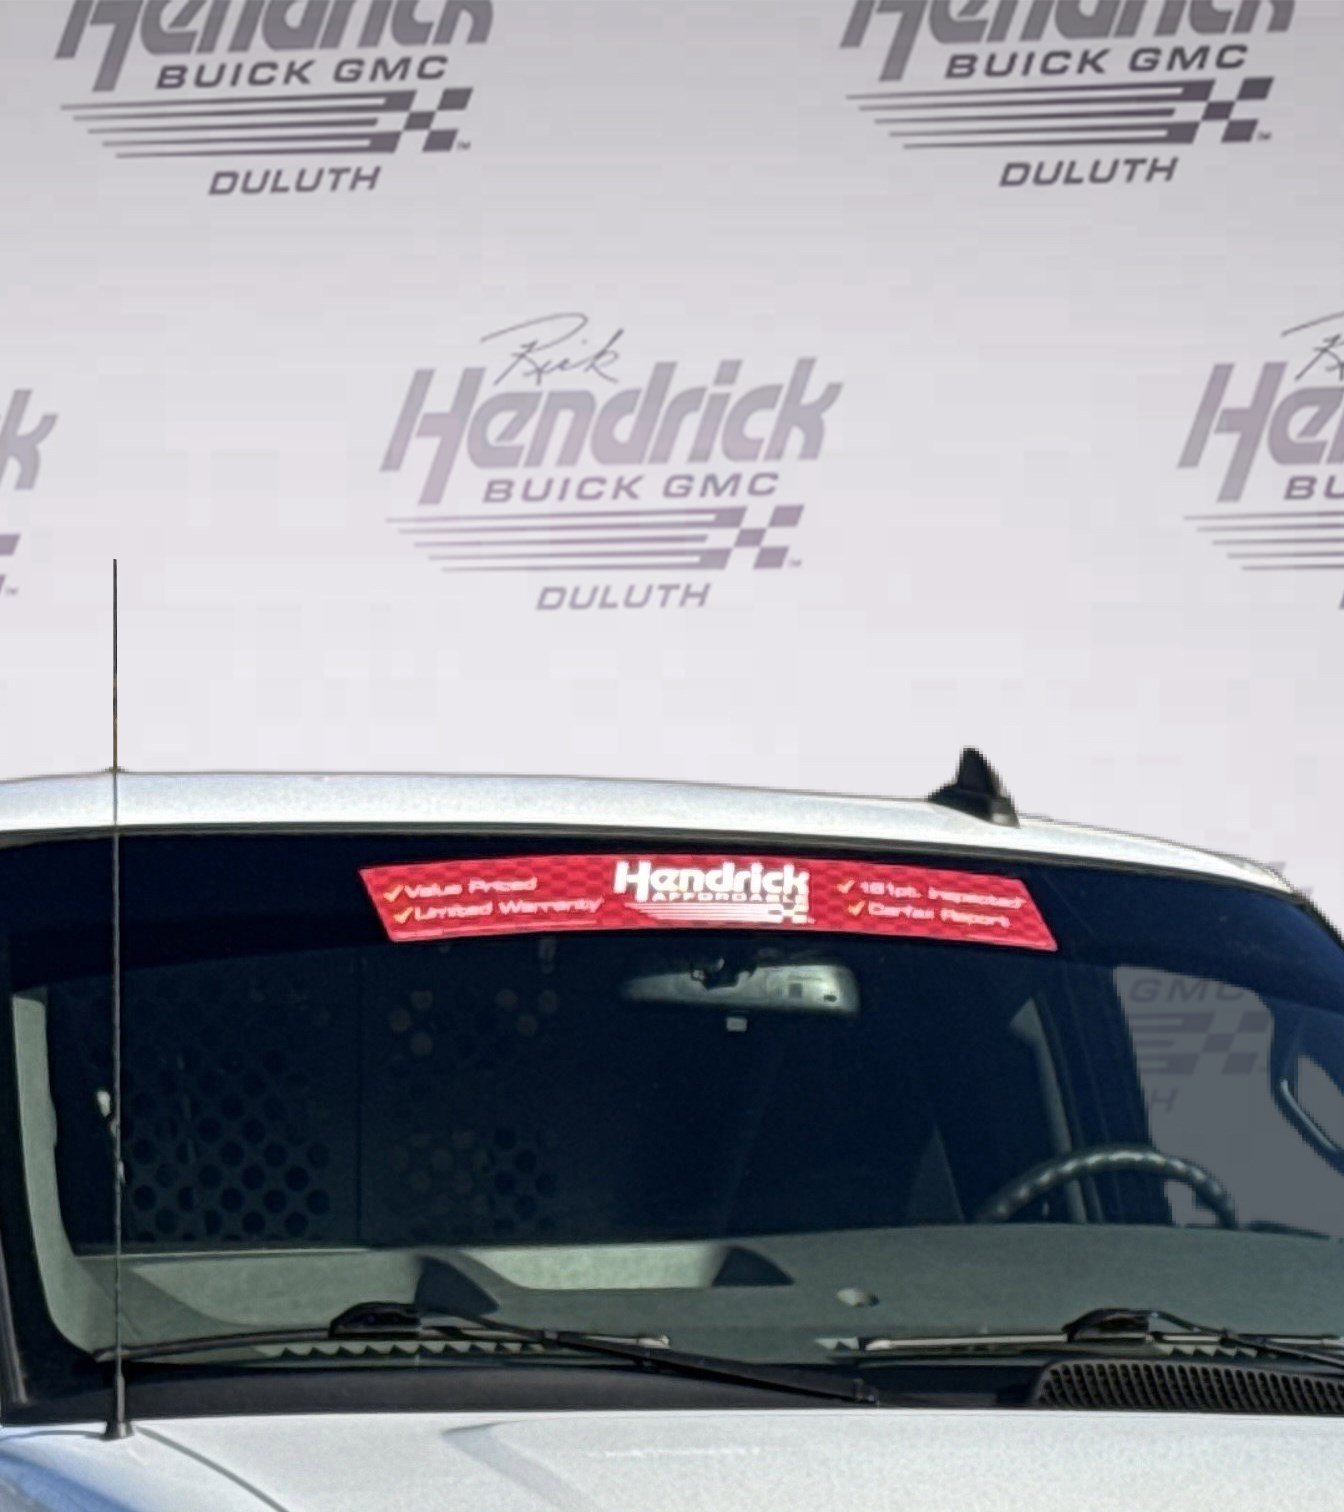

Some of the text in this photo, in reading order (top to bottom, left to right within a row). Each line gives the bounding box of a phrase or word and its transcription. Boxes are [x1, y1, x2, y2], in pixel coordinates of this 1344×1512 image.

[156, 56, 448, 89] BUICK GMC
[945, 44, 1248, 79] BUICK GMC
[208, 166, 381, 195] DULUTH
[999, 157, 1179, 186] DULUTH
[380, 357, 843, 505] Hendrick
[483, 473, 779, 503] BUICK GMC
[535, 583, 711, 611] DULUTH
[613, 860, 808, 902] Hendrick
